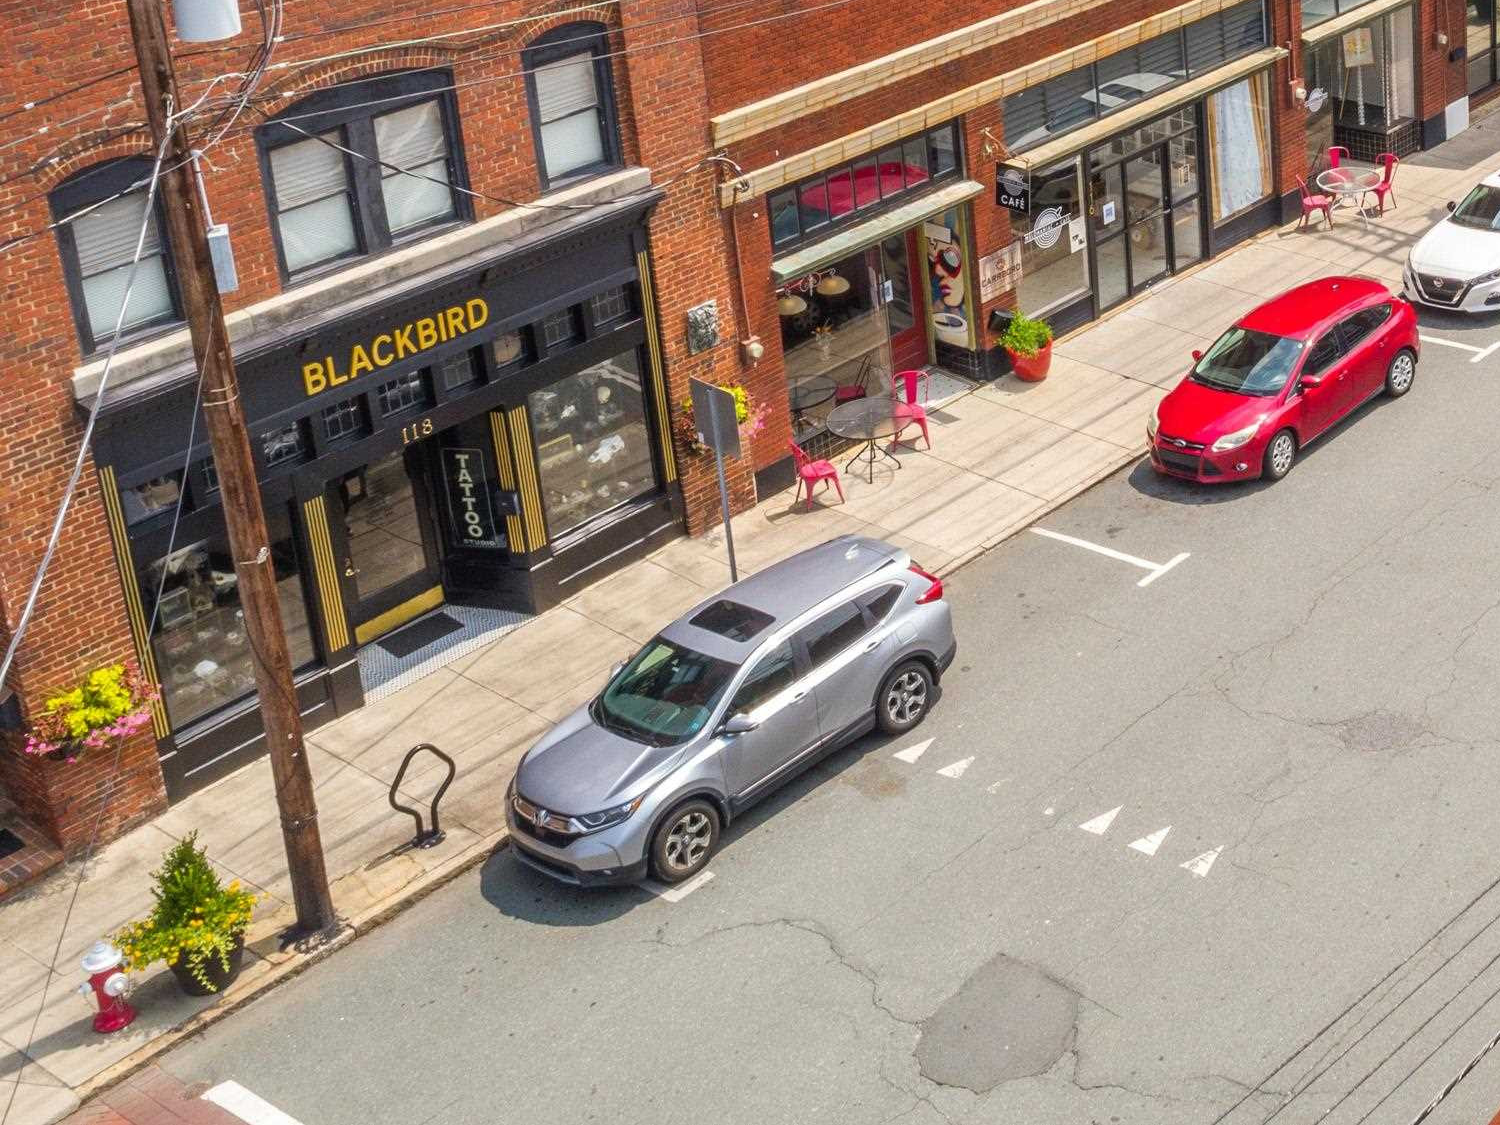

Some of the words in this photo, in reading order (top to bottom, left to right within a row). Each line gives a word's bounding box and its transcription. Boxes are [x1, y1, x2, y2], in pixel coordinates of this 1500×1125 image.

[1001, 194, 1025, 210] CAFÉ
[302, 297, 490, 397] BLACKBIRD
[402, 418, 433, 445] 118
[455, 454, 483, 537] TATTOO
